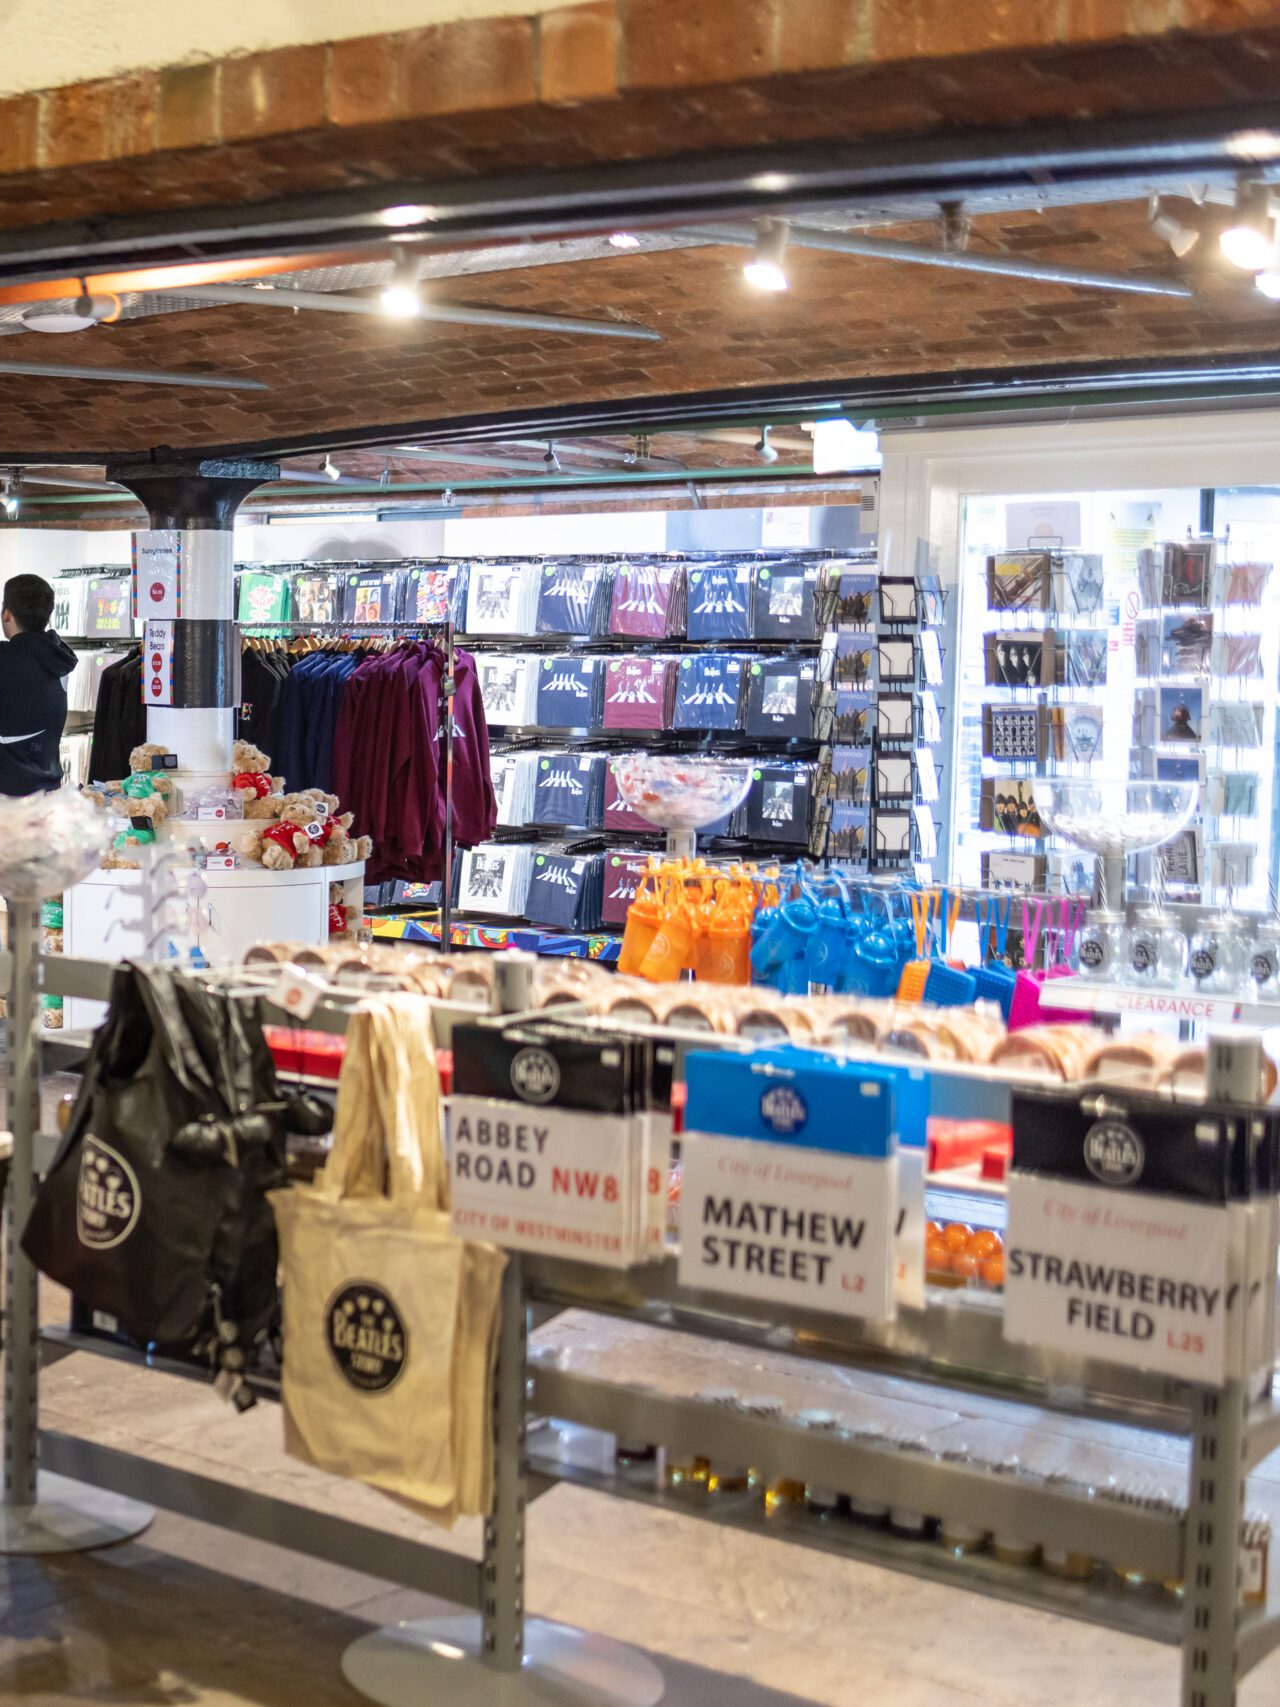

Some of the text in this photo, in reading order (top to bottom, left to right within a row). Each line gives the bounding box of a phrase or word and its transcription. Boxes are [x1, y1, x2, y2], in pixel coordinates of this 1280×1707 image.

[149, 629, 166, 639] Teddy
[1116, 993, 1215, 1018] CLEARANCE
[455, 1117, 549, 1154] ABBEY
[455, 1151, 619, 1203] ROAD NW8
[454, 1206, 621, 1251] CITY OF WESTMINSTER
[702, 1195, 866, 1250] MATHEW
[701, 1235, 866, 1294] STREET L2
[1009, 1248, 1220, 1317] STRAWBERRY
[1066, 1297, 1205, 1355] FIELD L25
